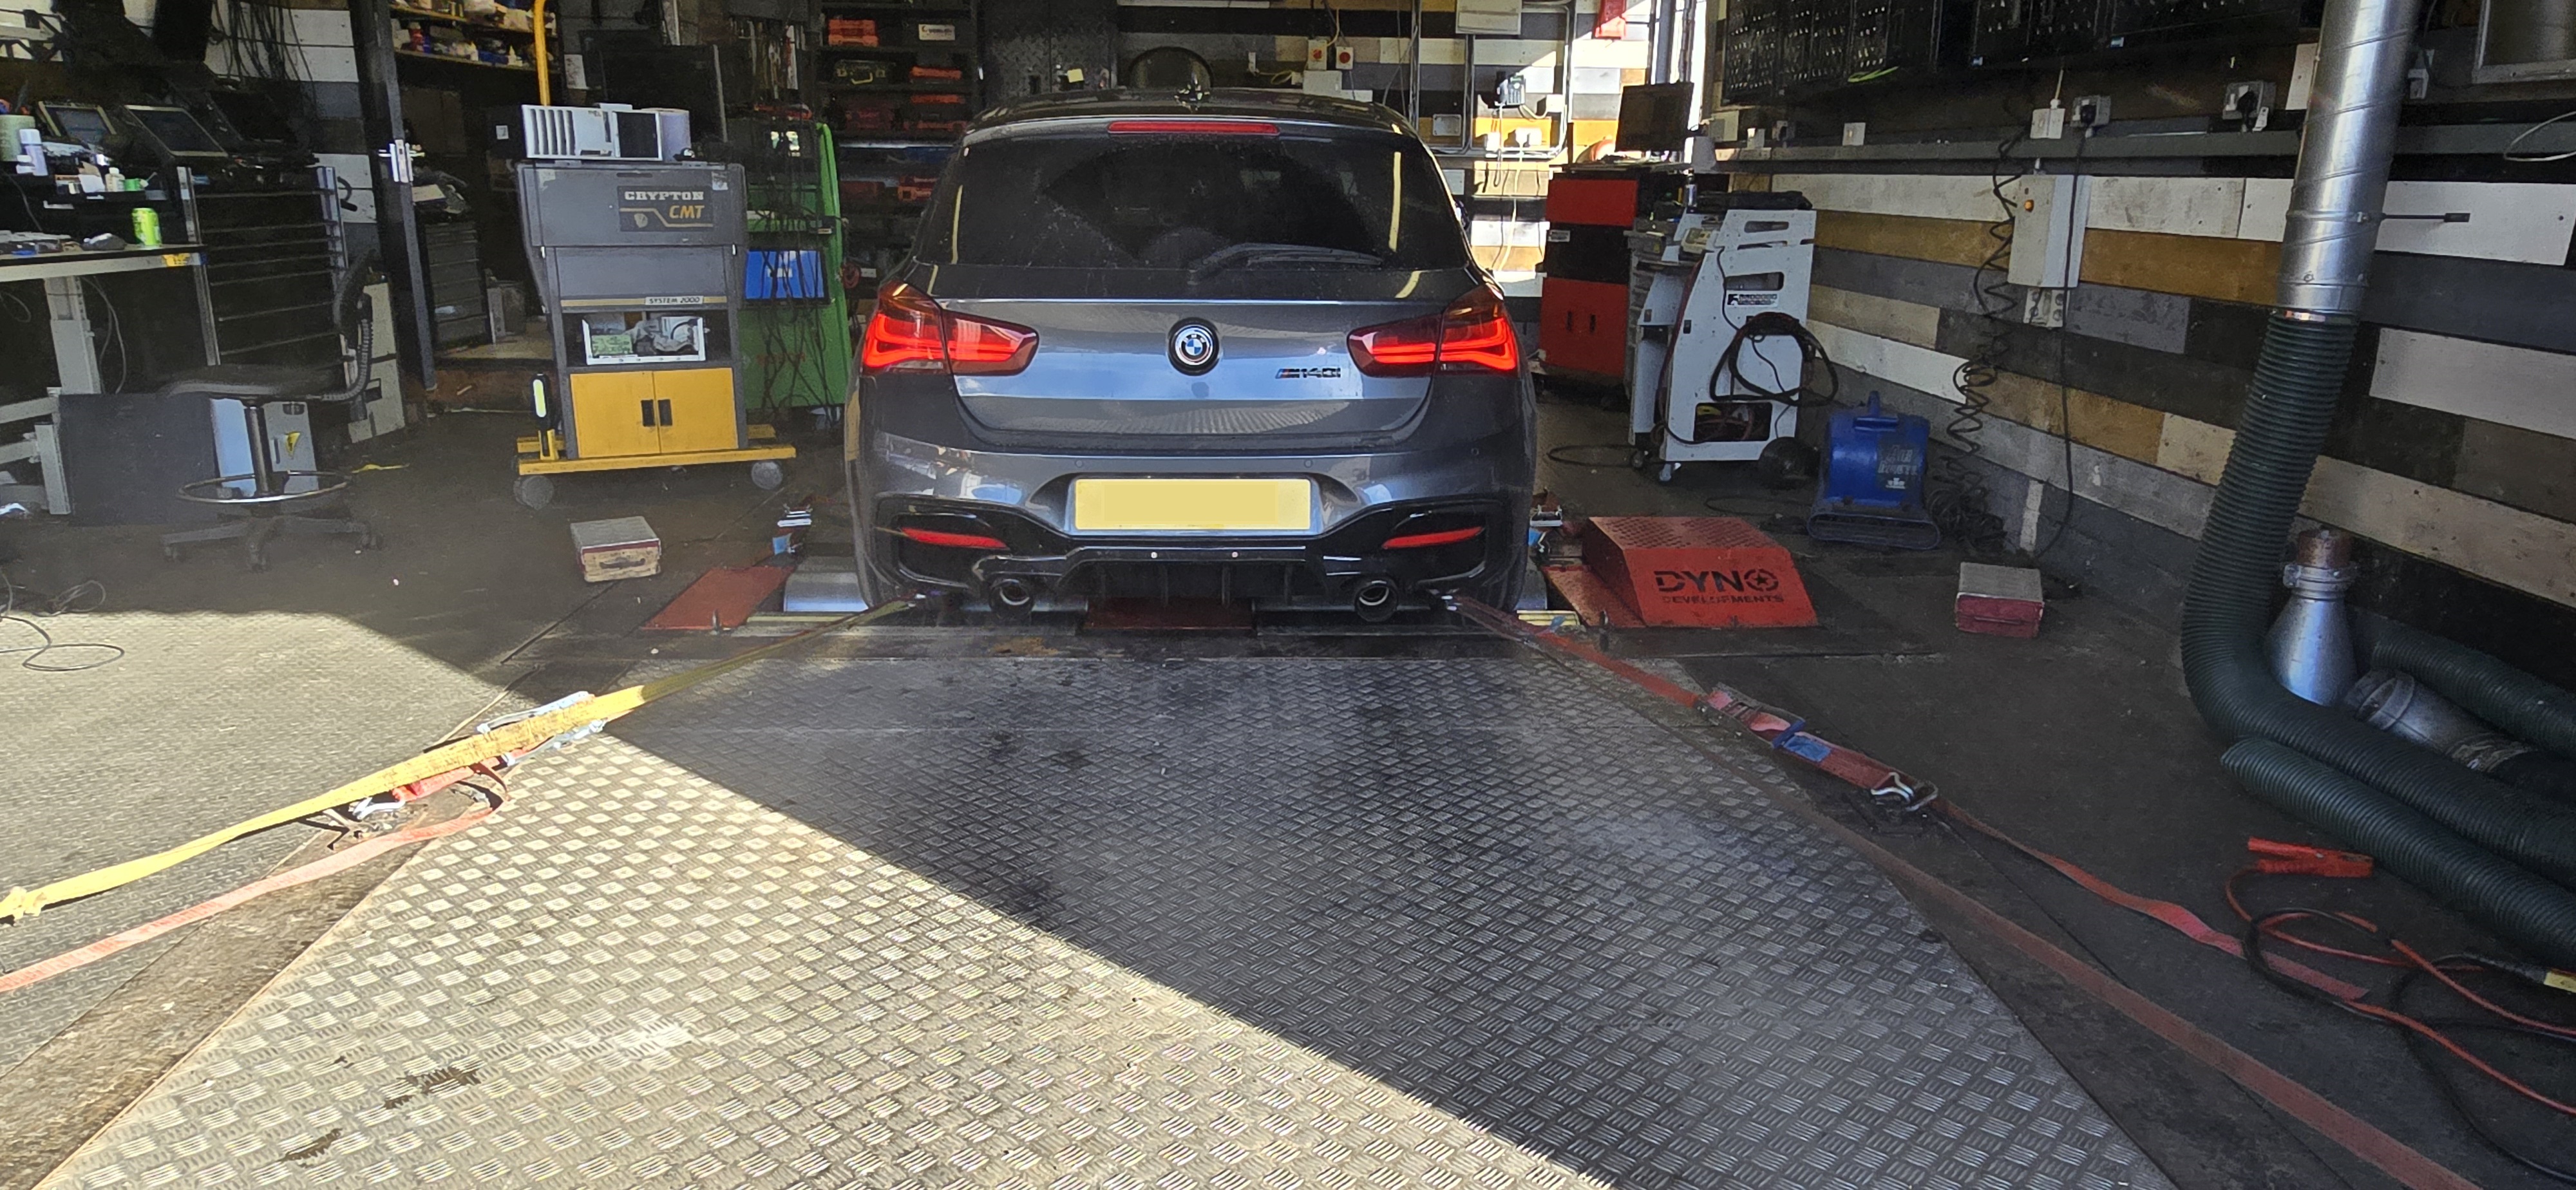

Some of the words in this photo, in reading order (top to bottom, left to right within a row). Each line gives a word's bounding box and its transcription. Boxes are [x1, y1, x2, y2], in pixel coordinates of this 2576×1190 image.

[625, 191, 704, 200] CRYPTON
[669, 205, 705, 219] CMT
[1653, 569, 1779, 592] DYNO
